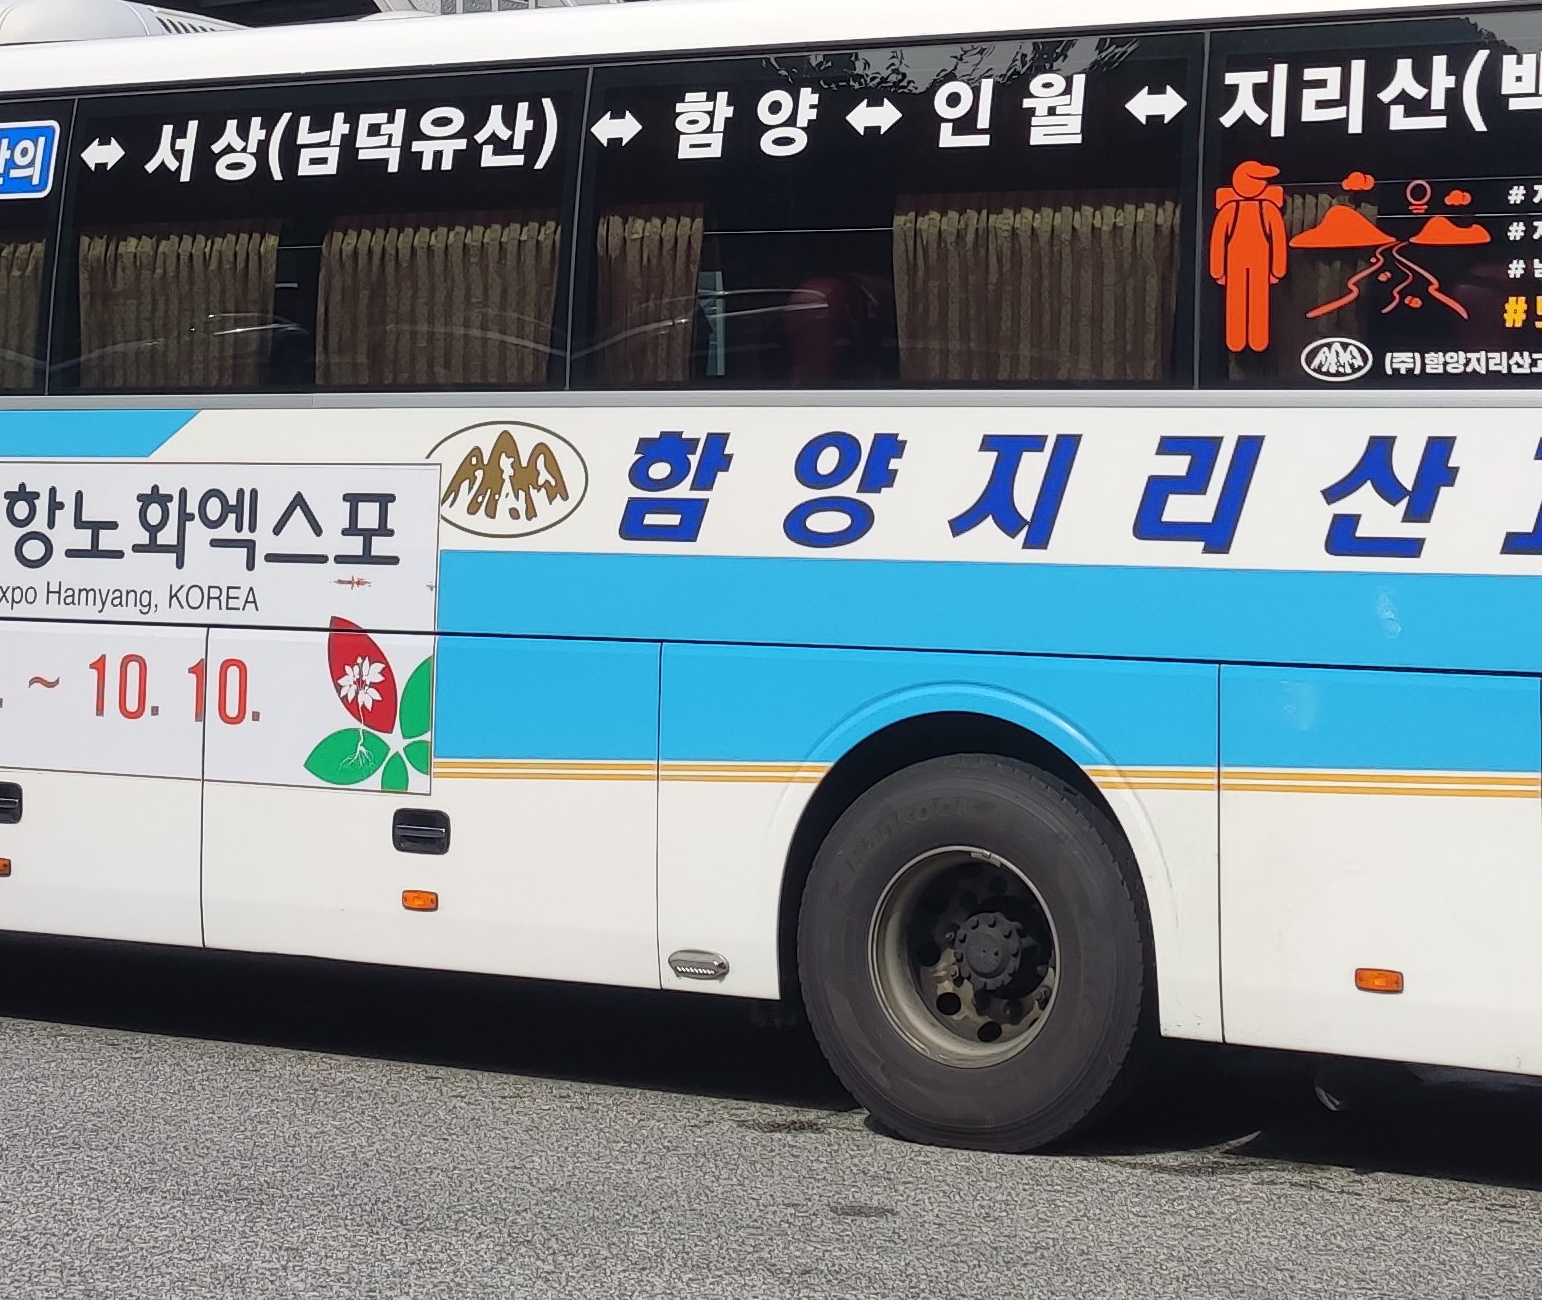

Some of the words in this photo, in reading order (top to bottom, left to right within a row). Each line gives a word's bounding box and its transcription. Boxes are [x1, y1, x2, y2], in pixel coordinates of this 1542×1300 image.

[143, 98, 559, 183] 서상(남덕유산)
[46, 581, 159, 615] Hamyang,
[168, 582, 260, 613] KOREA
[88, 653, 160, 719] 10.
[187, 657, 262, 726] 10.
